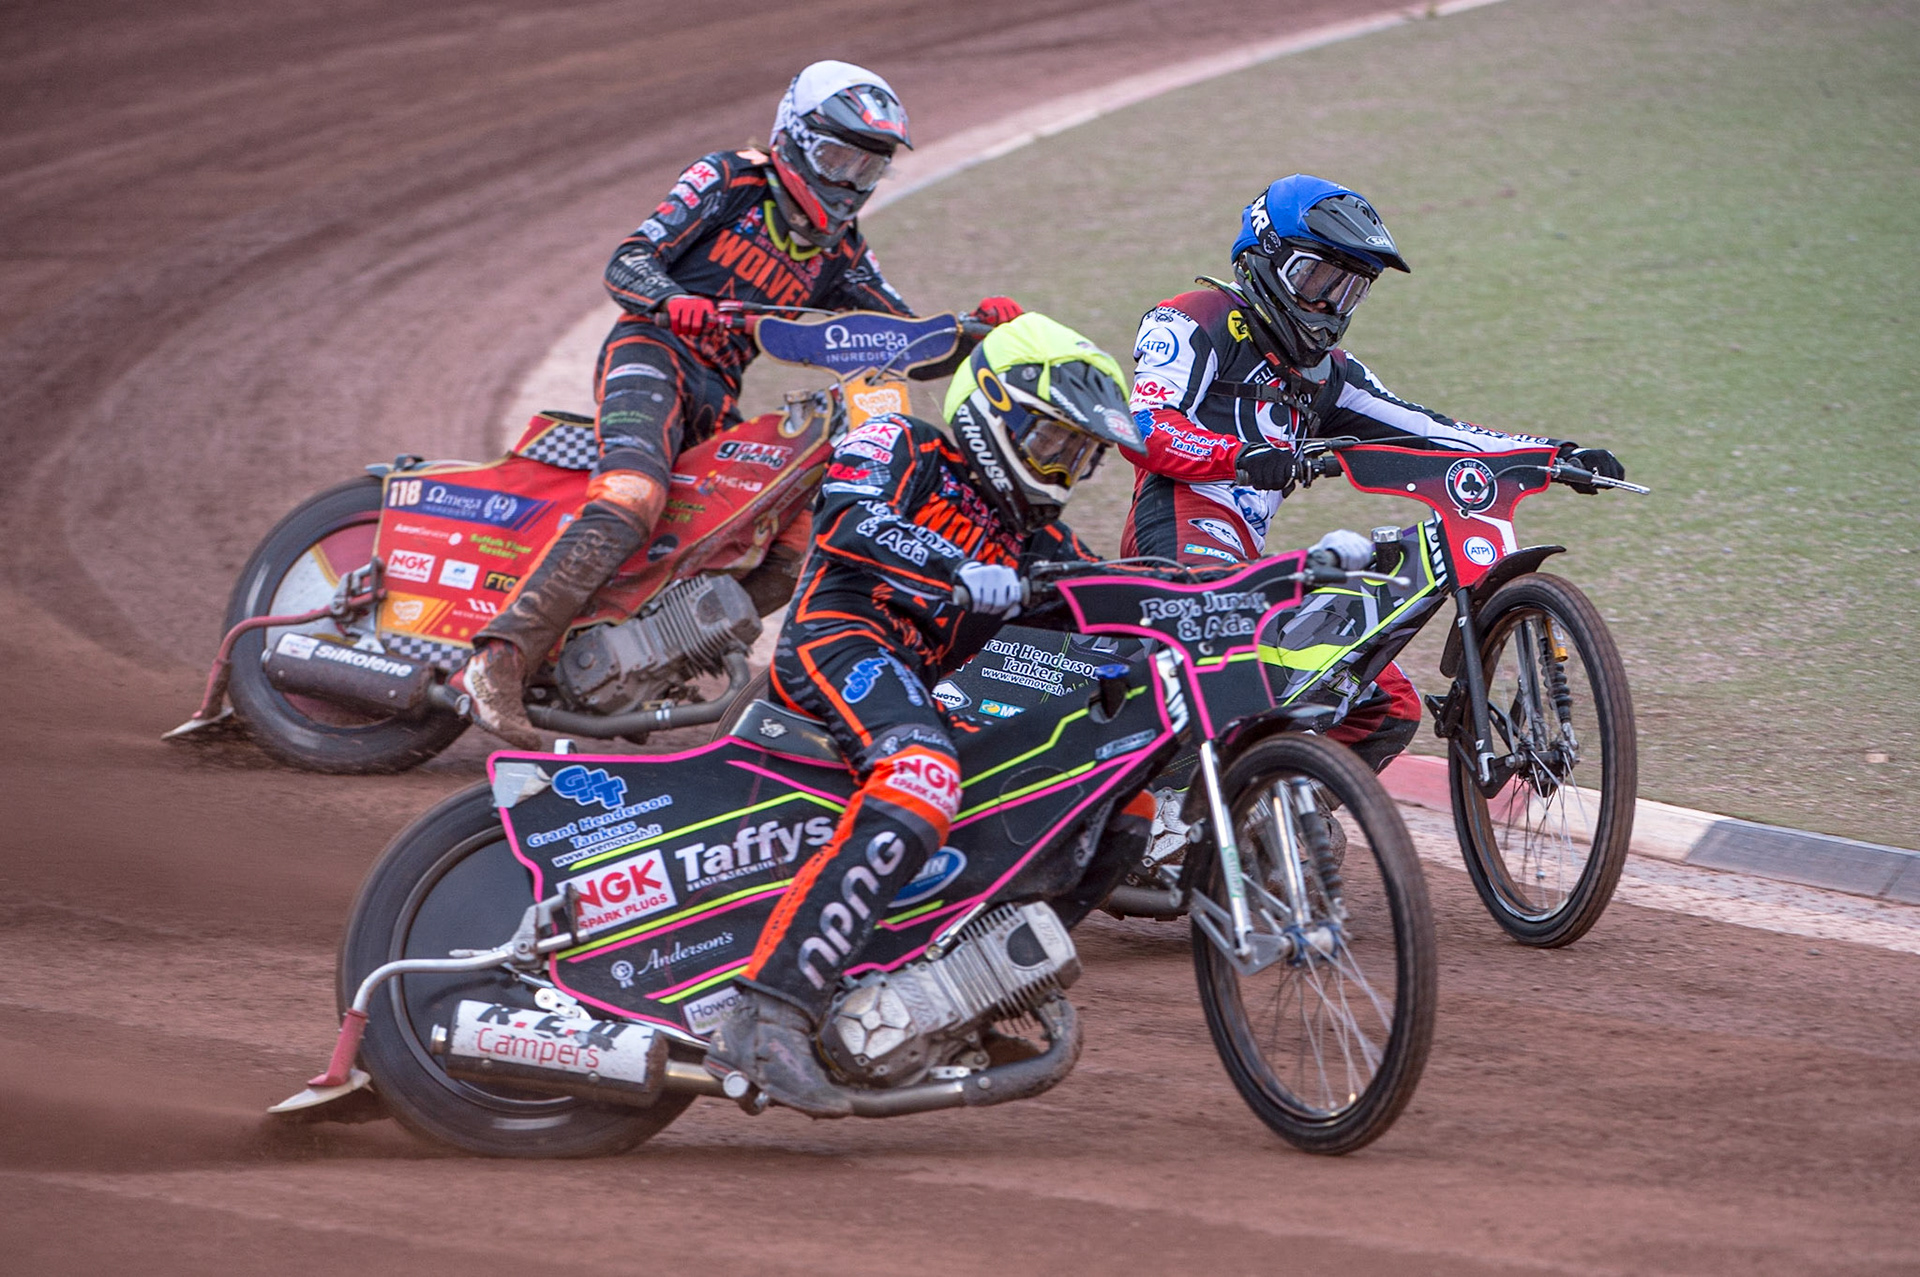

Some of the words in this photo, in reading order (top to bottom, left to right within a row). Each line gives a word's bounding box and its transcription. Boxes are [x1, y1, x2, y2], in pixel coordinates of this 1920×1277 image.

[1143, 340, 1171, 355] ATPI
[1133, 380, 1175, 401] NGK
[872, 448, 891, 463] 36
[1449, 463, 1462, 481] BELLE
[1479, 466, 1492, 481] ACES
[388, 480, 422, 507] 118
[875, 528, 929, 567] Ada
[1470, 546, 1491, 556] ATPI
[391, 553, 431, 572] NGK
[1177, 618, 1201, 642] &
[1204, 613, 1256, 640] Ada
[315, 644, 413, 678] Silkolene
[982, 639, 1021, 656] rant
[1002, 656, 1065, 683] Tankers
[527, 822, 579, 848] Grant
[578, 794, 673, 831] Henderson
[569, 821, 638, 849] Tankers
[675, 816, 834, 882] Taffys
[576, 858, 663, 917] NGK
[579, 908, 622, 929] SPARK
[624, 893, 668, 915] PLUGS
[637, 931, 735, 975] Anderson's
